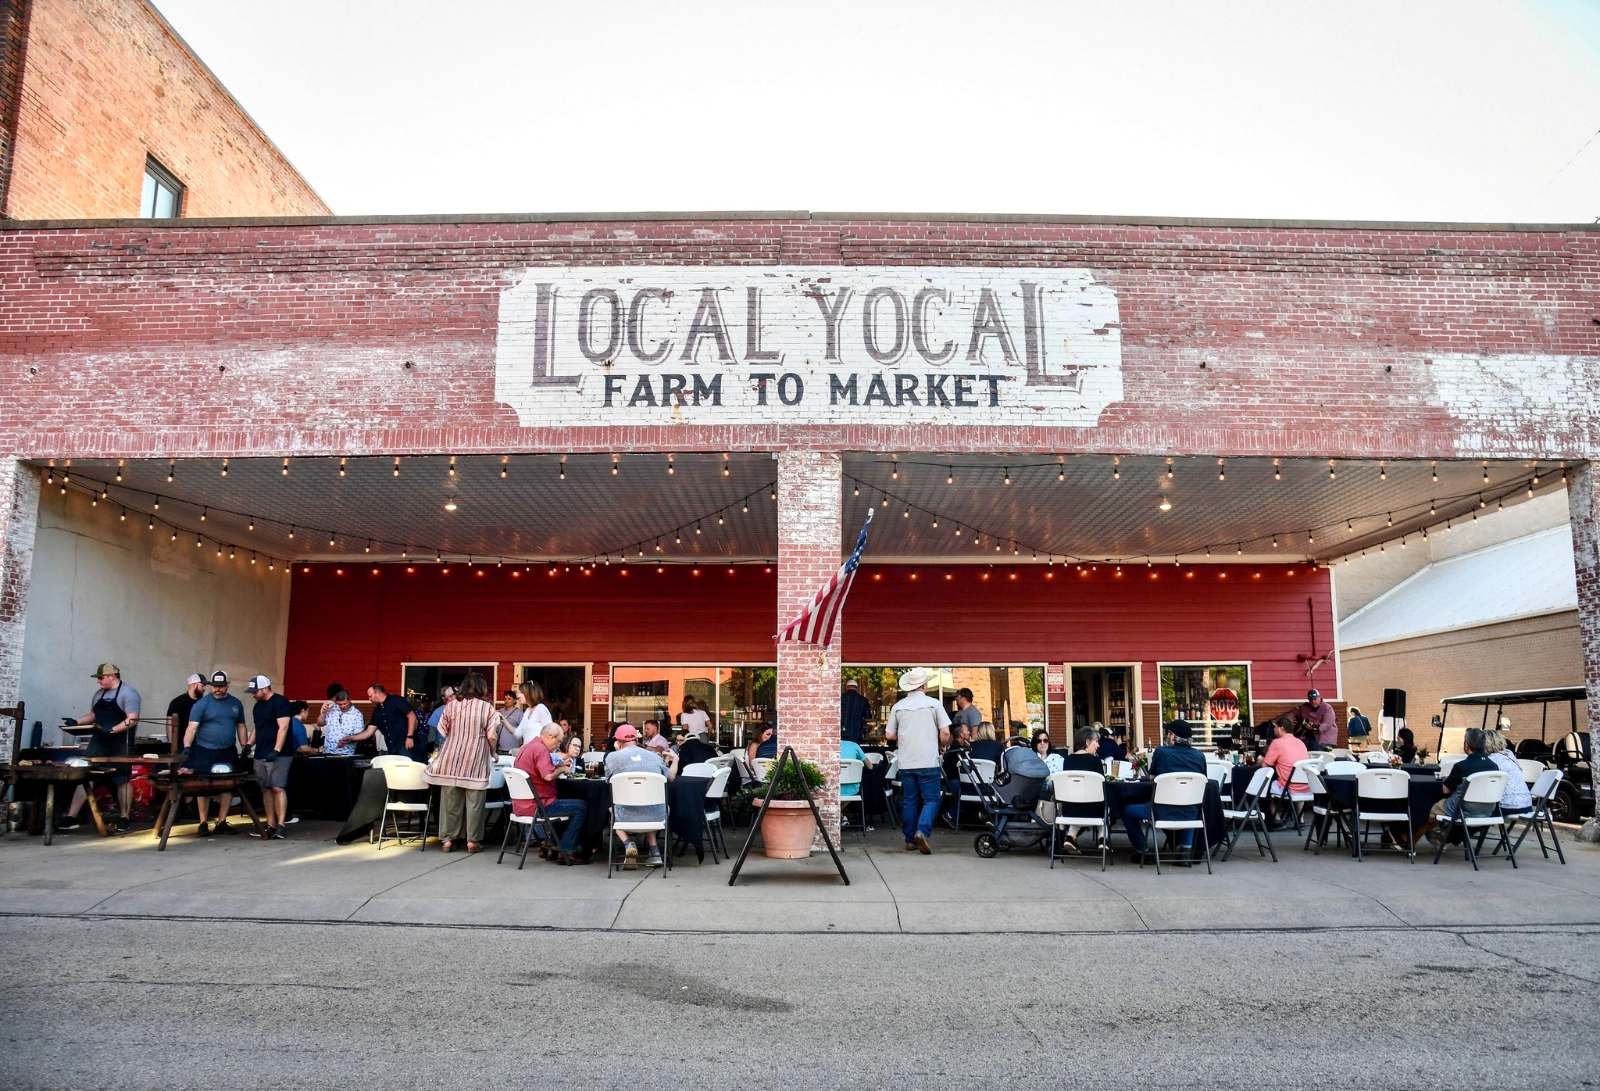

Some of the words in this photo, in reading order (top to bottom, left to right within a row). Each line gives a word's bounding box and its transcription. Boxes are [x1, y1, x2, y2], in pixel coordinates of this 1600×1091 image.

[531, 282, 785, 393] LOCAL
[807, 281, 1083, 393] YOCAL
[602, 373, 723, 407] FARM
[749, 372, 804, 406] TO
[828, 373, 1005, 407] MARKET
